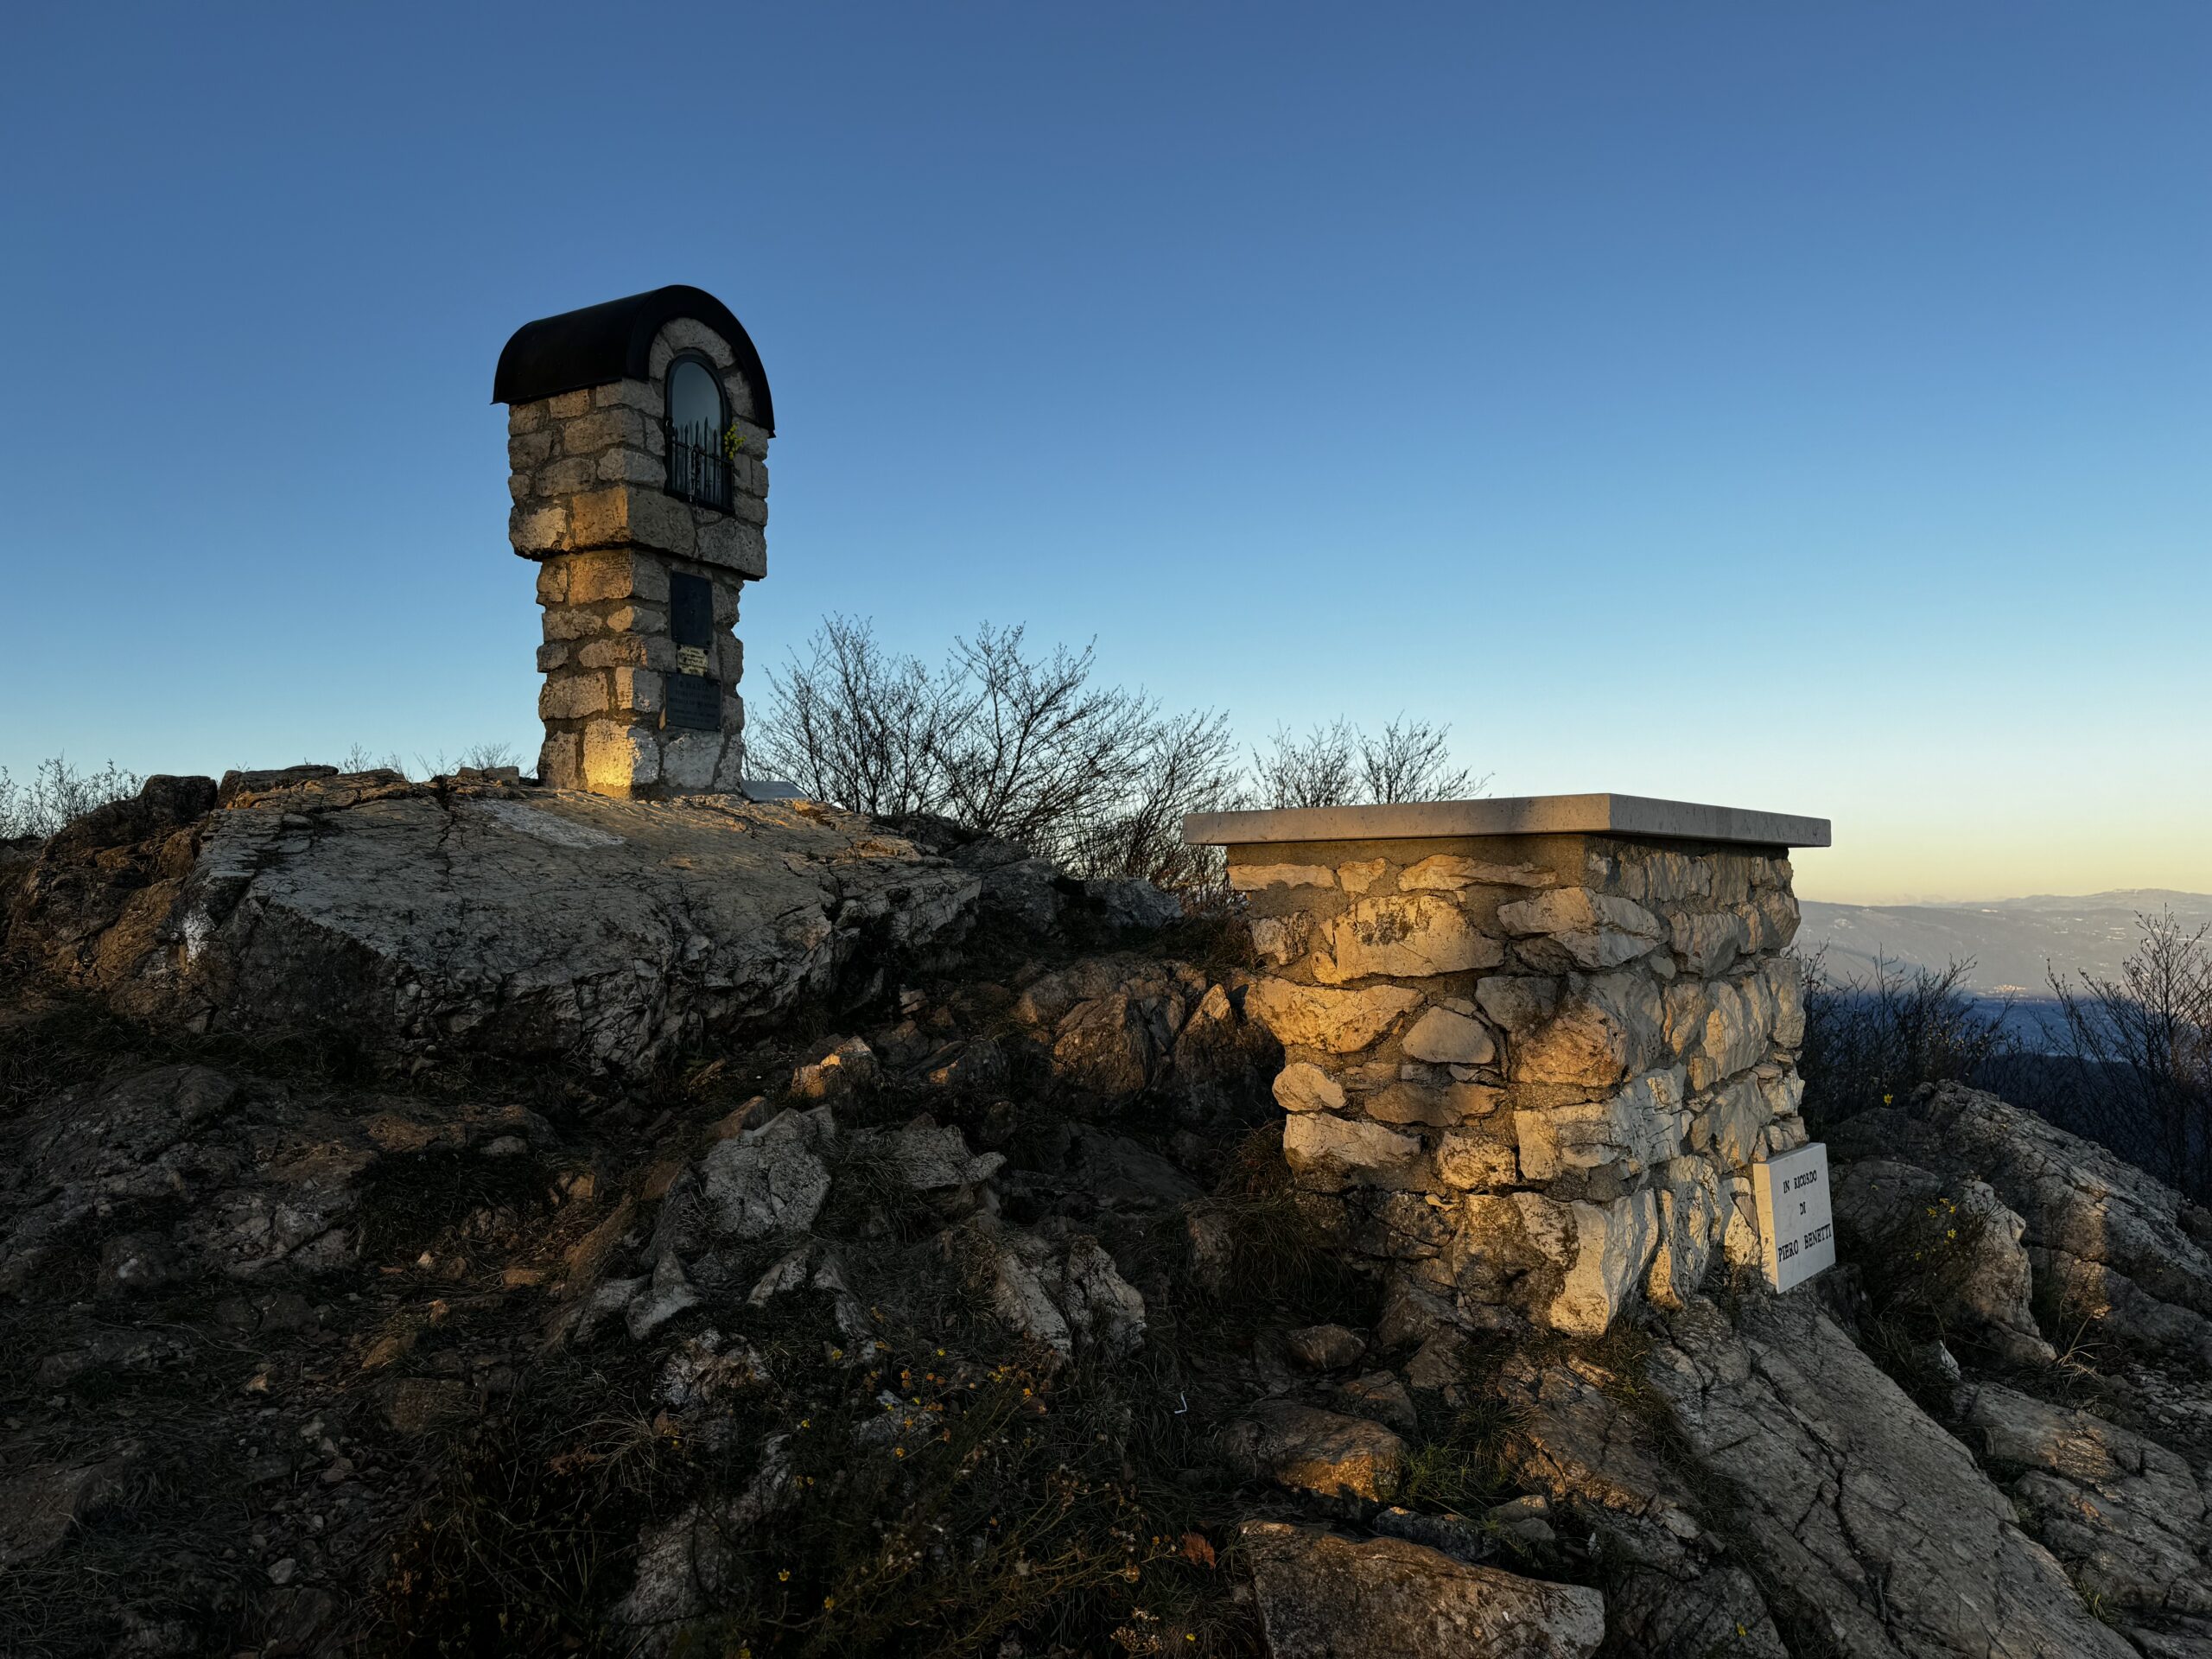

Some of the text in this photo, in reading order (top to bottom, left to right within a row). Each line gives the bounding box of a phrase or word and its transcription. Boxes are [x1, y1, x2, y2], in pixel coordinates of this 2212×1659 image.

[1783, 1170, 1817, 1193] IN RICORDO
[1800, 1201, 1806, 1215] DI
[1778, 1224, 1832, 1262] PIERO BENETTI
